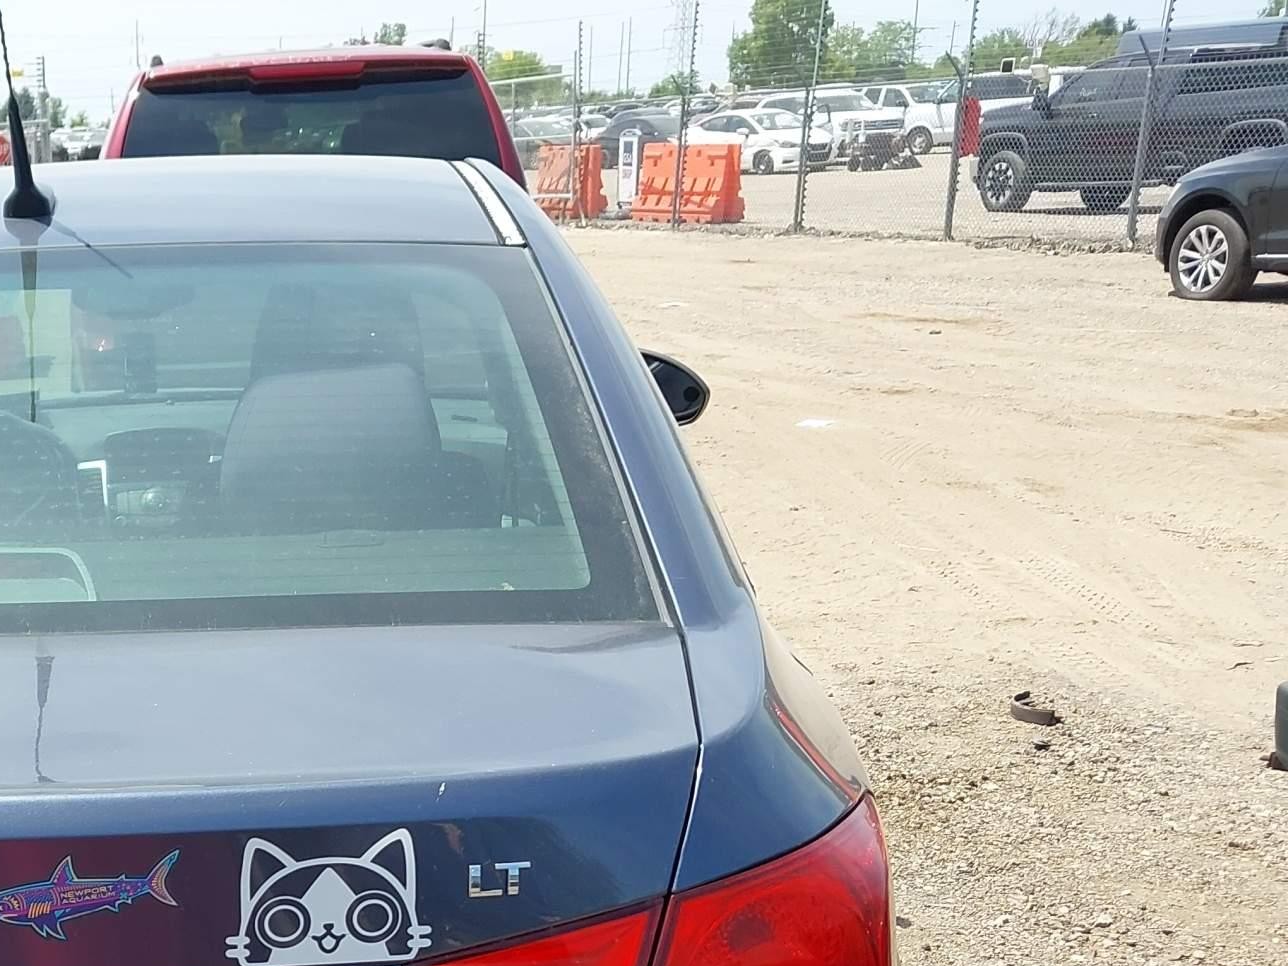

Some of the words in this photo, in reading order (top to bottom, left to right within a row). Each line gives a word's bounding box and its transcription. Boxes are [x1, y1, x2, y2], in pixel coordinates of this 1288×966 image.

[469, 861, 531, 897] LT
[60, 885, 113, 899] NEWPORT
[61, 892, 116, 905] AQUARIUM
